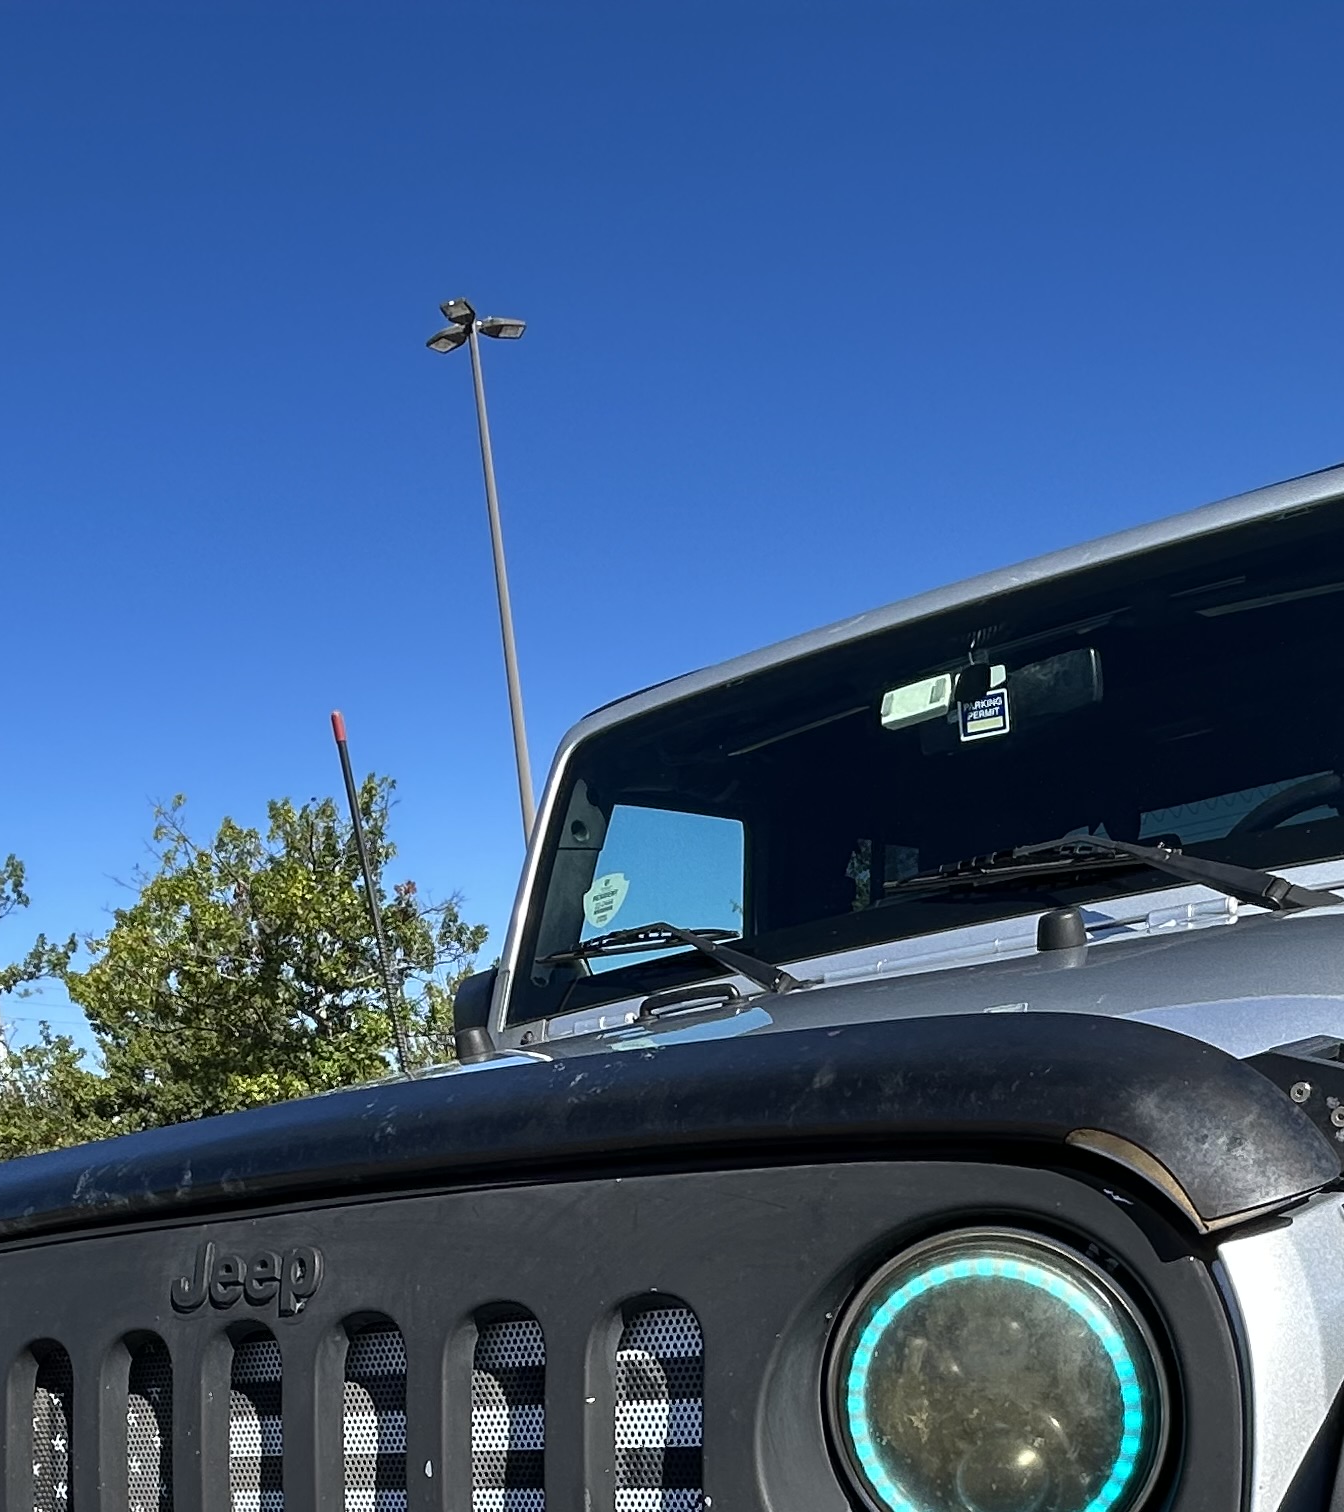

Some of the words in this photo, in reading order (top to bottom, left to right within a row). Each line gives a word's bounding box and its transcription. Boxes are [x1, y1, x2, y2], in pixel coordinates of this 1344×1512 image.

[963, 696, 1003, 711] PARKING
[967, 706, 1000, 720] PERMIT
[170, 1241, 325, 1318] Jeep
